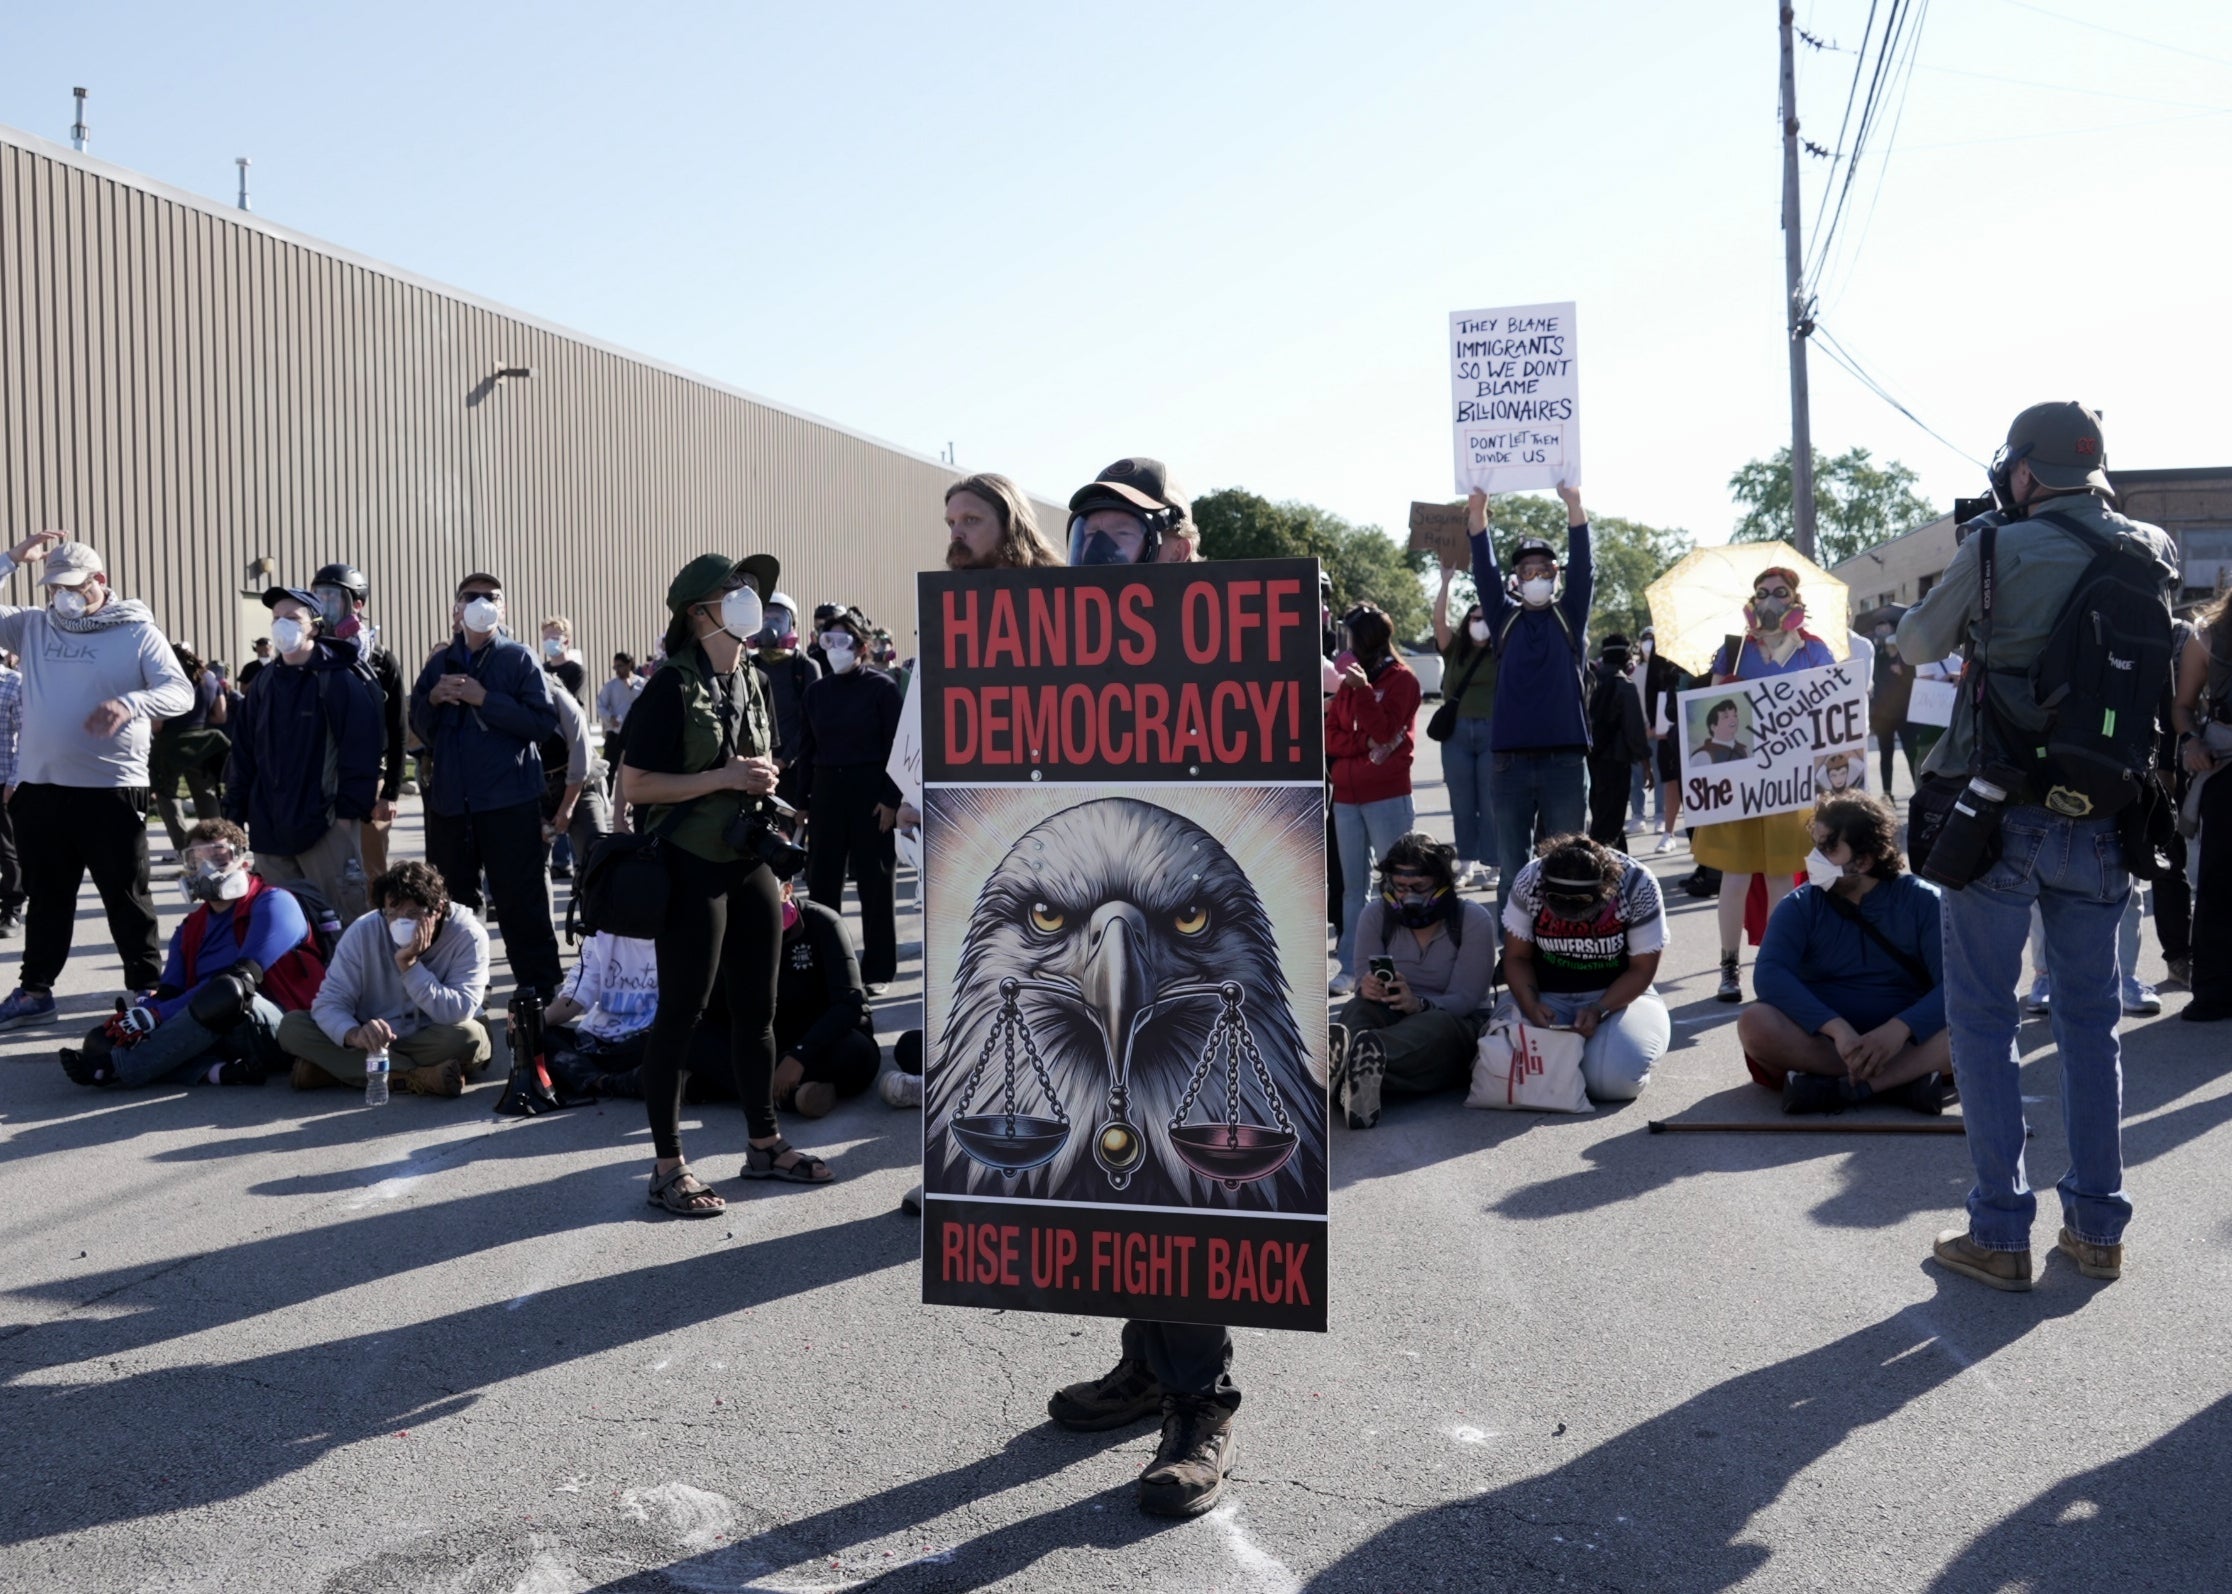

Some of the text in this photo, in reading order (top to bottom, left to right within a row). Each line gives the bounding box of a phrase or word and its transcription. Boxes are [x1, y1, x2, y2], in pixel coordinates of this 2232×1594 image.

[1457, 317, 1559, 334] THEY BLAME
[1457, 336, 1565, 359] IMMIGRANTS
[1457, 361, 1480, 380] SO
[1488, 361, 1517, 378] WE
[1476, 379, 1540, 398] BLAME
[1456, 398, 1572, 422] BILLIONAIRES
[1509, 430, 1531, 448] LET
[1523, 449, 1546, 463] US
[942, 578, 1301, 669] HANDS OFF
[1744, 681, 1795, 721] He
[1746, 667, 1852, 742] Wouldn't
[943, 680, 1301, 765] DEMOCRACY!
[1752, 727, 1808, 769] Join
[1807, 699, 1863, 751] ICE
[1685, 765, 1813, 815] She Would
[1536, 932, 1624, 954] UNIVERSITIES
[942, 1221, 1312, 1307] RISE UP. FIGHT BACK
